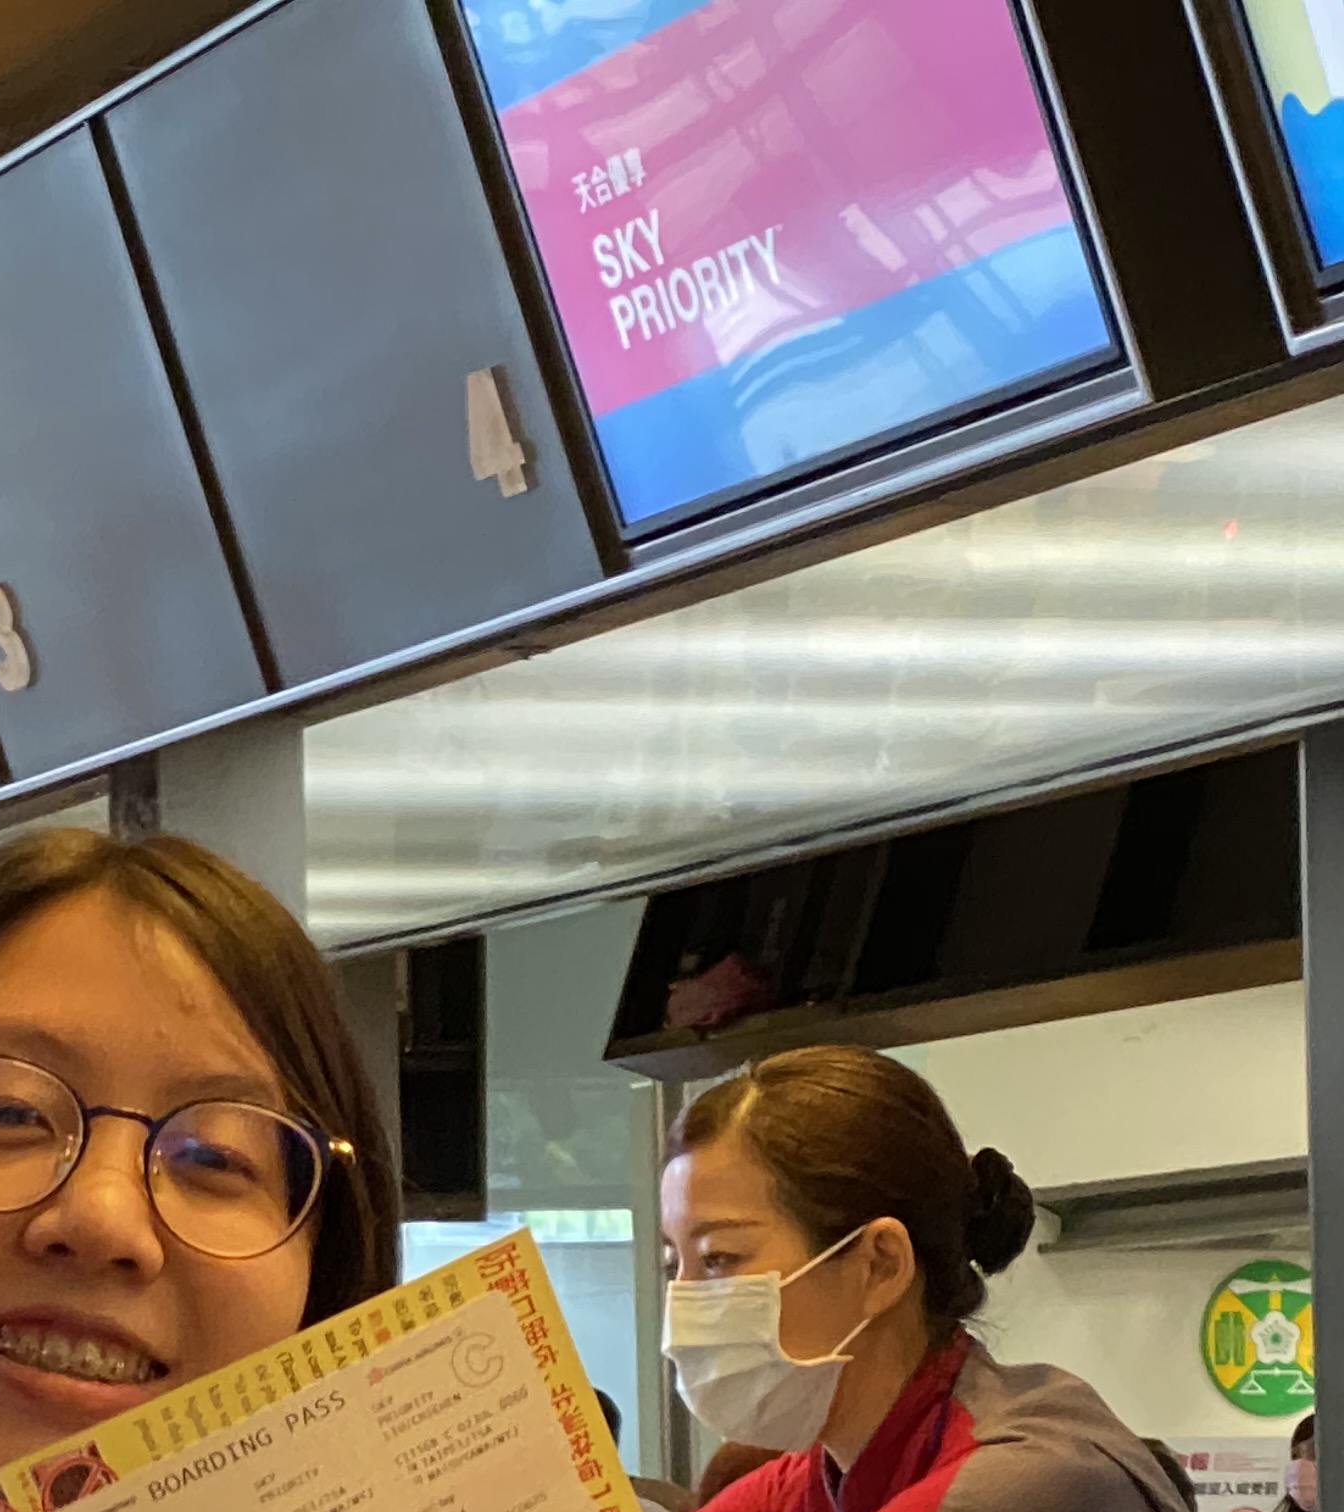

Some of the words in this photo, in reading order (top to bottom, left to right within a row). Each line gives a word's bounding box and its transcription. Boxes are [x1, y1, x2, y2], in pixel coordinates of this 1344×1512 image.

[592, 208, 664, 289] SKY
[609, 228, 780, 350] PRIORITY
[466, 365, 527, 498] 4
[147, 1427, 273, 1503] BOARDING
[284, 1389, 347, 1434] PASS
